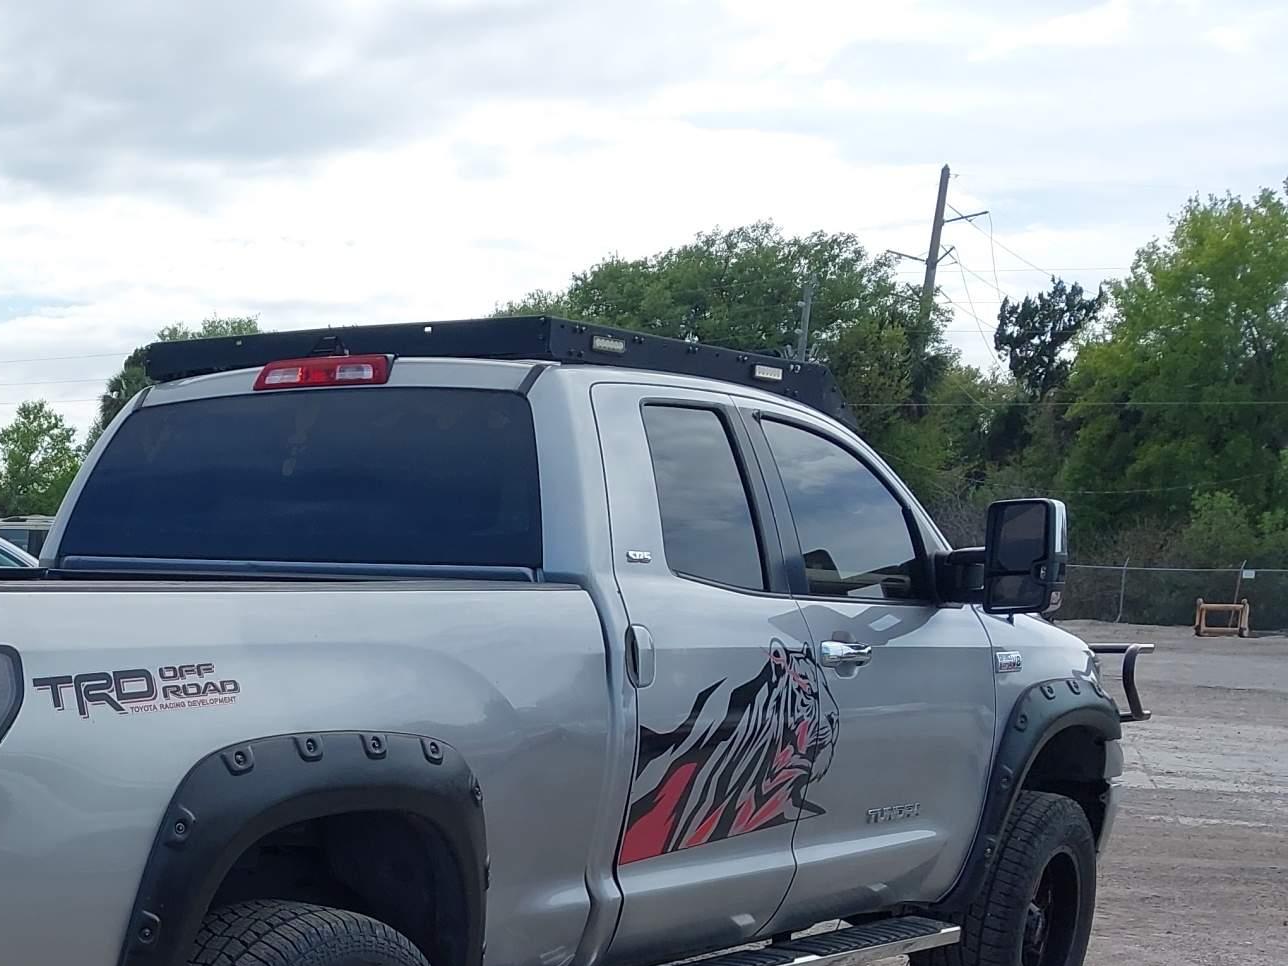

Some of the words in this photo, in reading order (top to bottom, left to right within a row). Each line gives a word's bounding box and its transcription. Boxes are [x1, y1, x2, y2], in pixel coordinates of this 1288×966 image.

[158, 662, 215, 681] OFF
[32, 669, 158, 719] TRD
[162, 679, 241, 701] ROAD
[130, 703, 158, 713] TOYOTA
[159, 701, 187, 711] RACING
[187, 696, 237, 707] DEVELOPMENT
